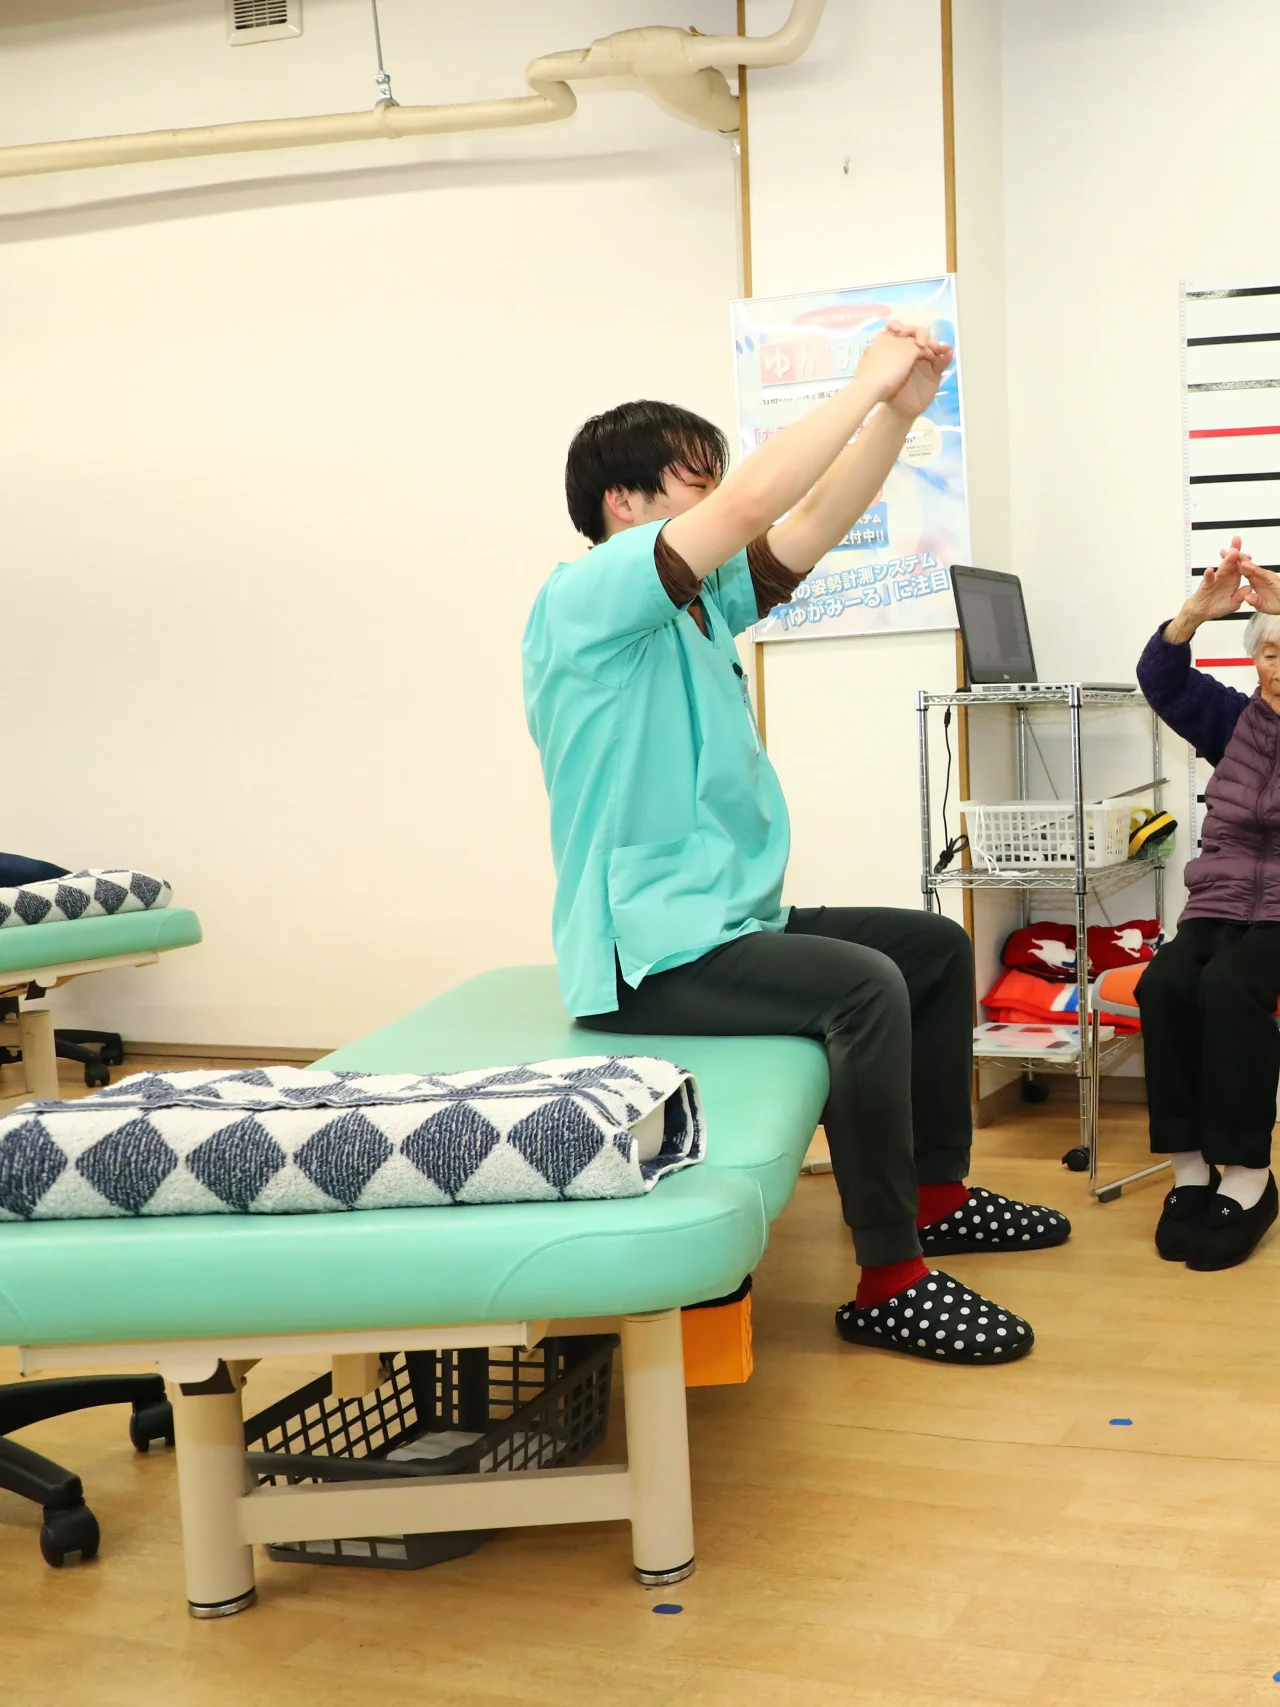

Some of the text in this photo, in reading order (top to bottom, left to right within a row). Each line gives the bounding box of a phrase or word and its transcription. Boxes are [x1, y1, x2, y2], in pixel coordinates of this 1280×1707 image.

[791, 551, 939, 602] の姿勢計測システム
